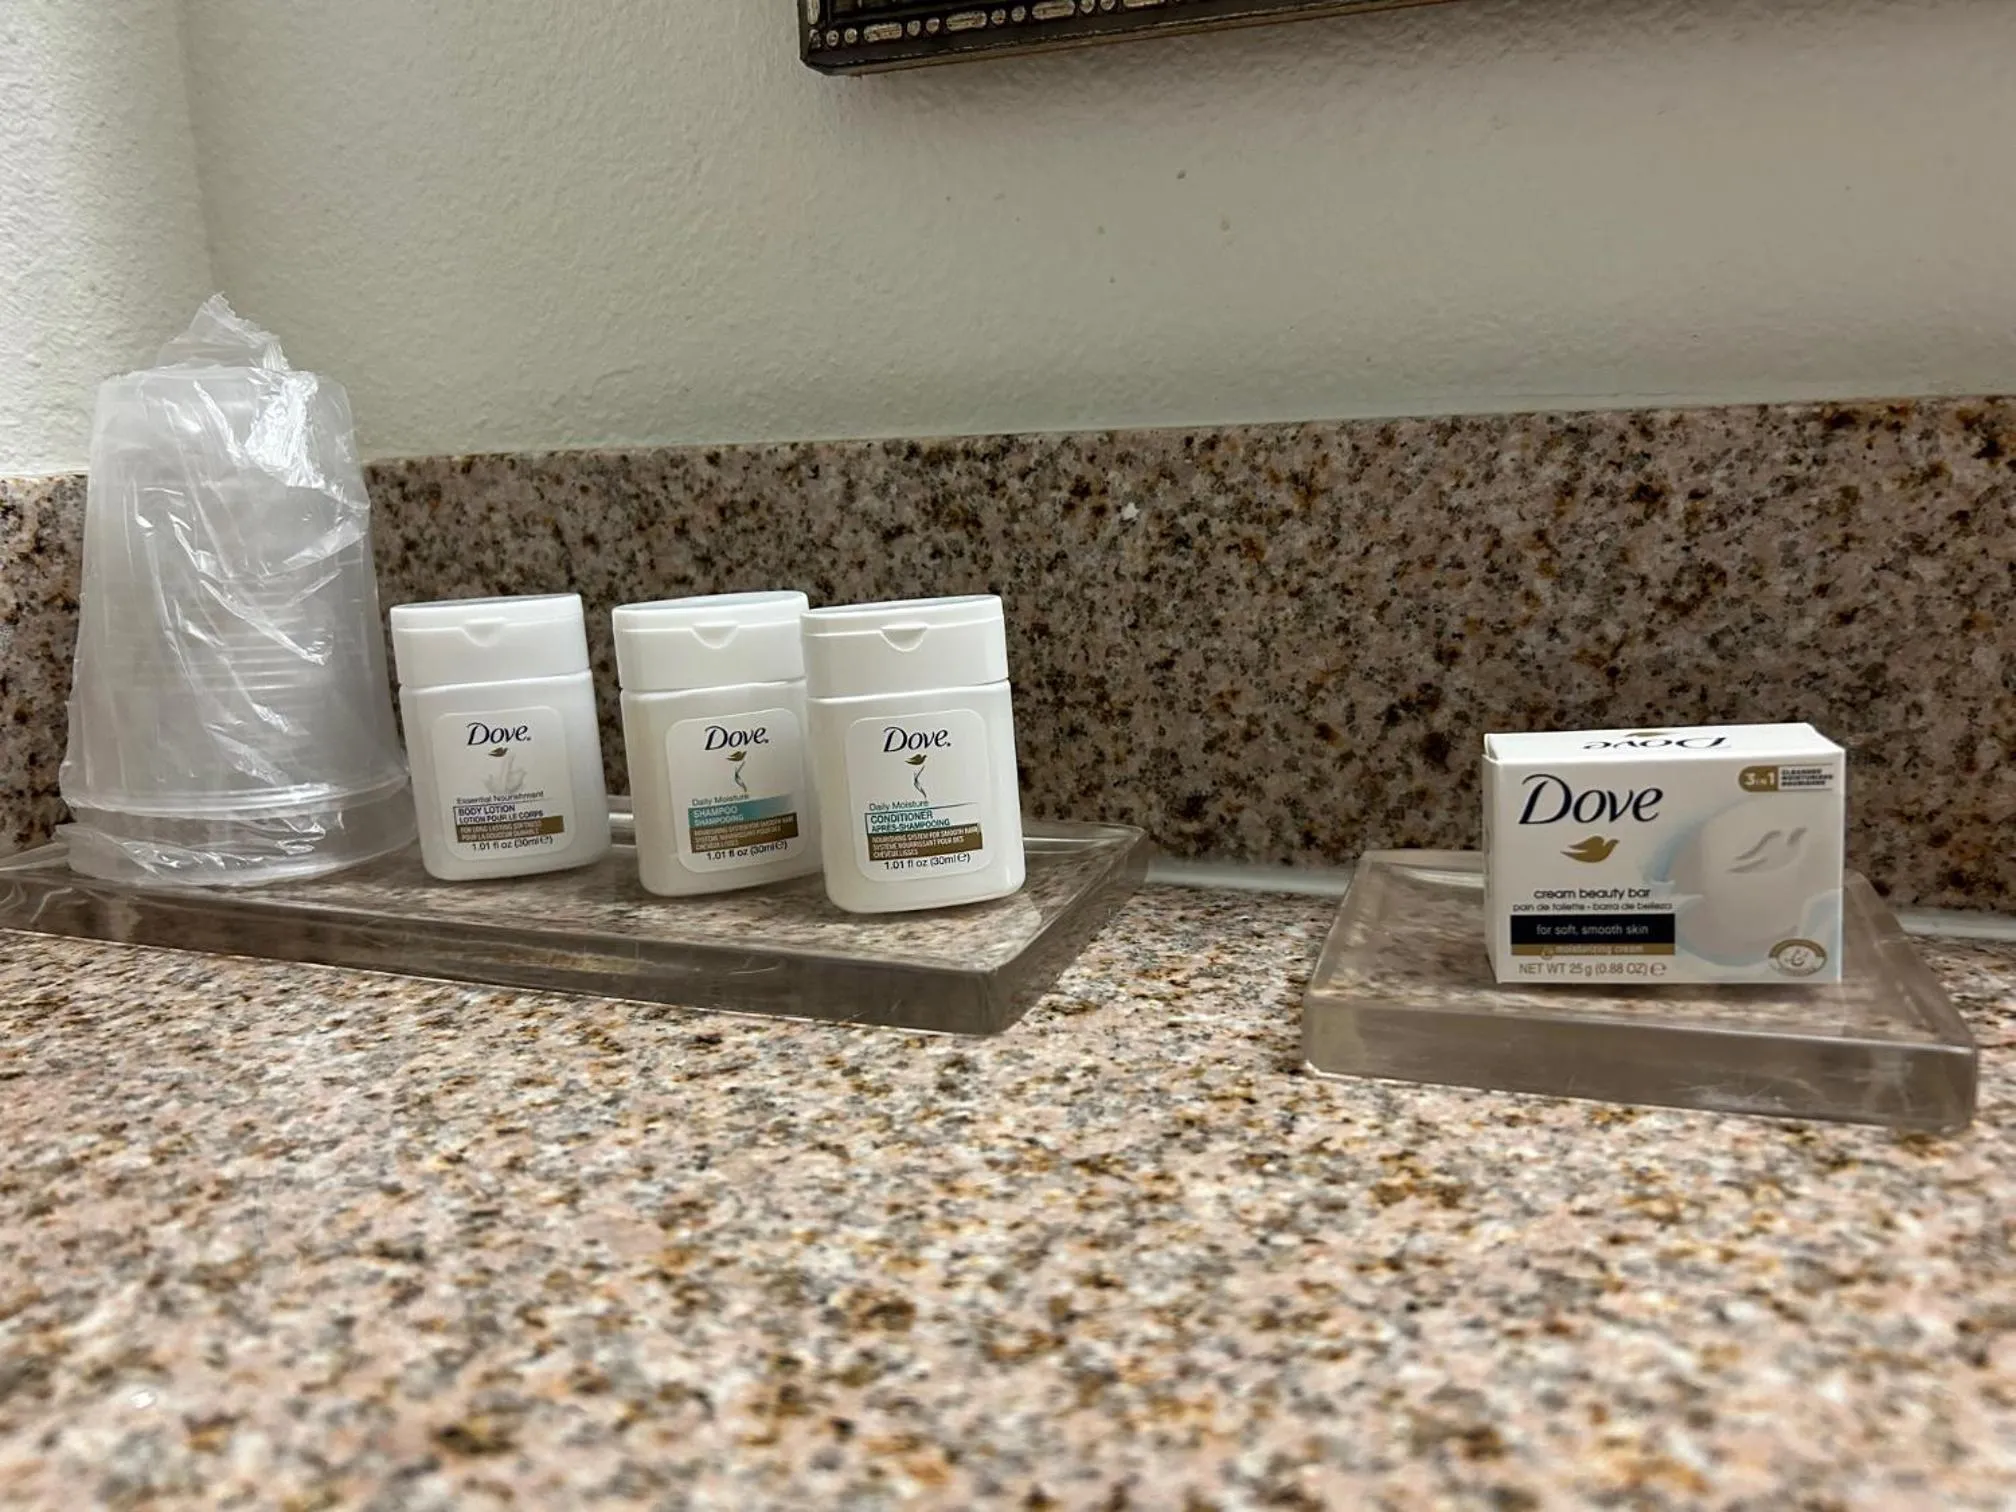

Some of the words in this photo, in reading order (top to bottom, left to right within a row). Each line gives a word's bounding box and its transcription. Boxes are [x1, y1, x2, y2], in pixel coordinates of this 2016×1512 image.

[1583, 737, 1731, 749] Dove
[493, 790, 544, 802] Nourishment
[692, 798, 711, 807] Daily
[714, 794, 749, 804] Moisture
[1518, 773, 1663, 825] Dove
[458, 806, 482, 817] BODY
[483, 804, 515, 815] LOTION
[693, 805, 738, 818] SHAMPOO
[869, 803, 889, 812] Daily
[892, 800, 929, 810] Moisture
[459, 815, 485, 824] LOTION
[487, 813, 508, 823] POUR
[519, 810, 544, 820] CORPS
[870, 810, 934, 824] CONDITIONER
[472, 842, 490, 851] 1.01
[501, 841, 512, 849] oz
[706, 850, 726, 860] 1.01
[737, 848, 748, 857] oz
[884, 860, 904, 870] 1.01
[916, 859, 927, 868] oz
[1533, 889, 1576, 900] cream
[1579, 887, 1625, 900] beauty
[1628, 887, 1652, 898] bar
[1513, 903, 1534, 912] pain
[1536, 902, 1550, 911] de
[1552, 901, 1586, 911] toilette
[1592, 901, 1619, 911] barra
[1621, 901, 1635, 910] de
[1637, 901, 1672, 910] belleza
[1536, 924, 1552, 936] for
[1581, 924, 1623, 936] smooth
[1626, 924, 1649, 935] skin
[1519, 963, 1544, 975] NET
[1546, 963, 1566, 975] WT
[1626, 962, 1648, 976] OZ)
